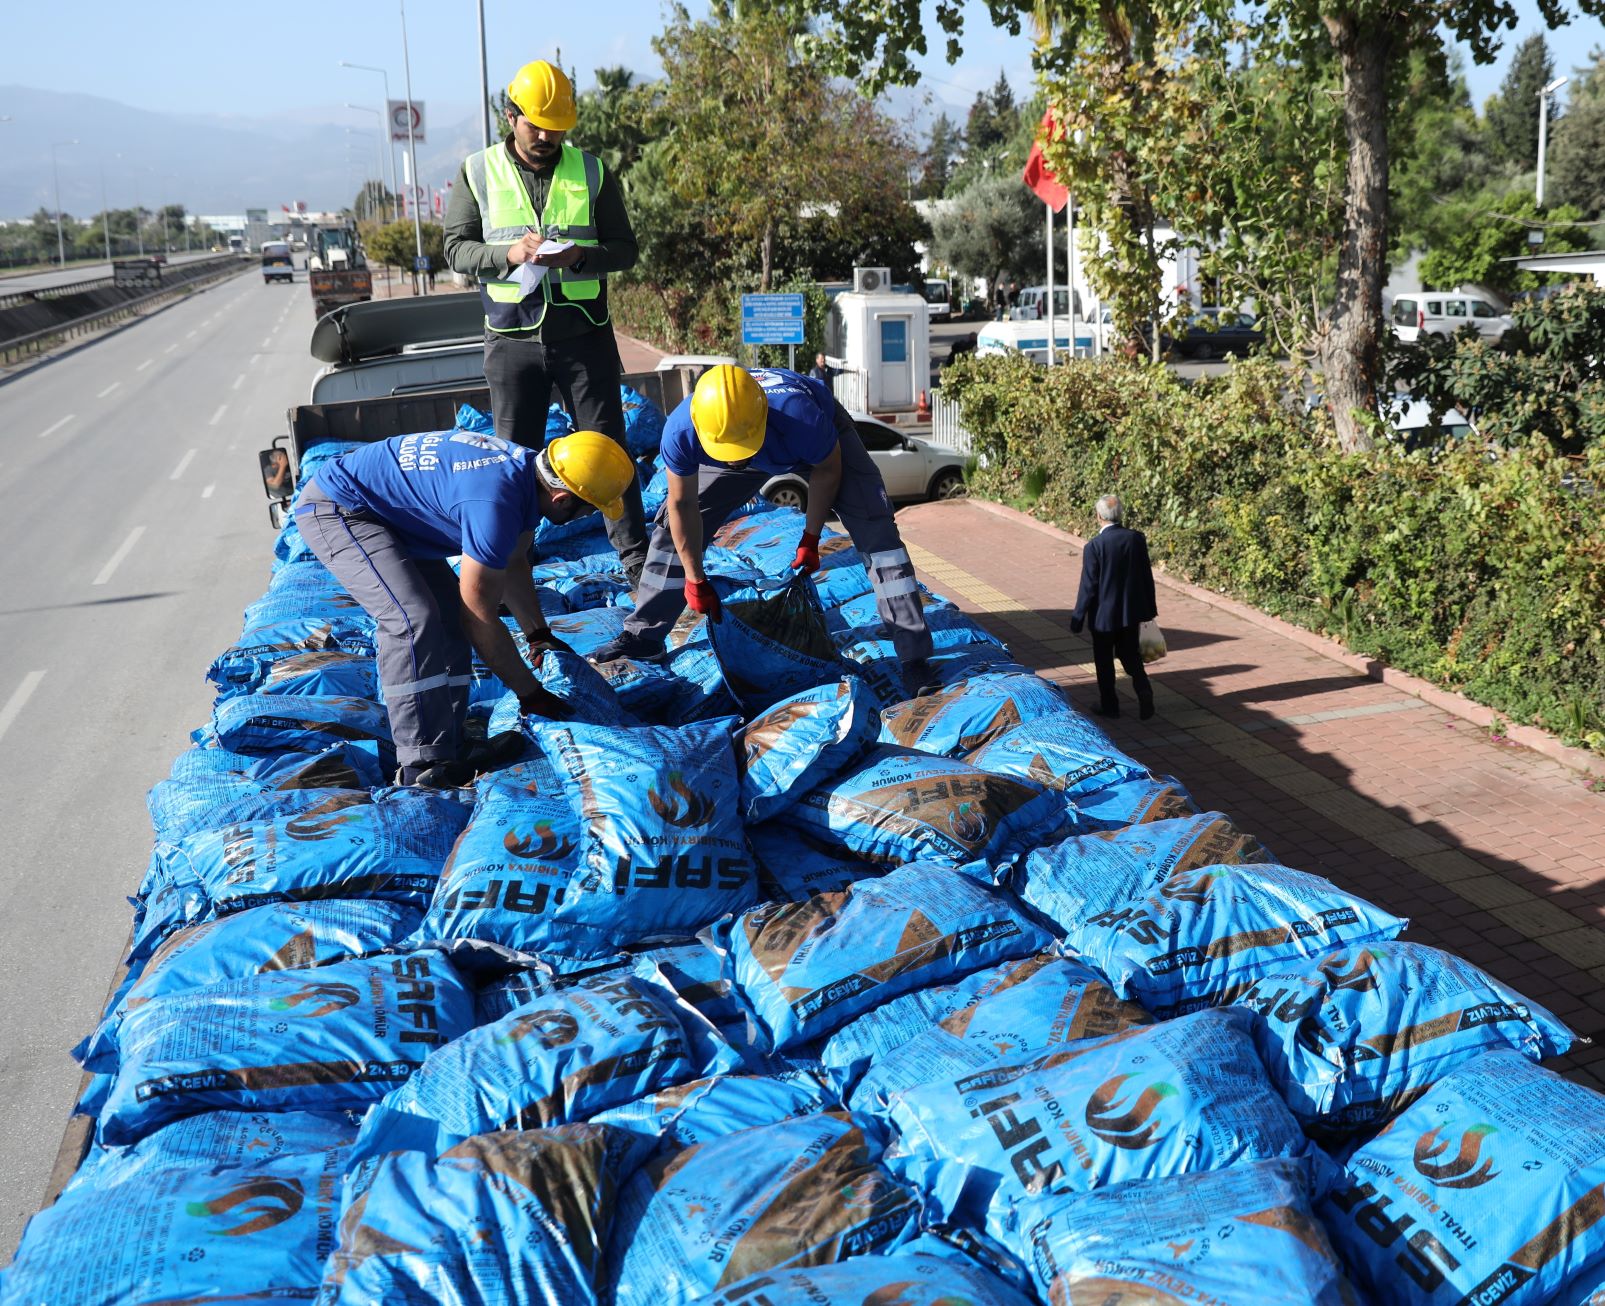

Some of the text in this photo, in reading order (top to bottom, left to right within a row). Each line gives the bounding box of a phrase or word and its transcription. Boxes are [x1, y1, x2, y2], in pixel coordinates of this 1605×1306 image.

[871, 773, 912, 788] KÖMÜR
[903, 779, 989, 813] AFİ
[508, 864, 559, 876] SİBİRYA
[614, 852, 751, 896] SAFİ
[392, 957, 449, 1044] SAFİ
[827, 977, 863, 1001] CEVİZ
[182, 1074, 227, 1090] CEVİZ
[369, 1064, 410, 1077] CEİZ
[969, 1091, 1076, 1196] AFİ
[1059, 1119, 1094, 1171] SİBİRYA
[1393, 1174, 1441, 1215] SİBİRYA
[315, 1214, 337, 1263] KÖMÜR
[707, 1216, 750, 1264] KÖMÜR
[848, 1222, 889, 1252] CEVİZ
[1329, 1175, 1462, 1294] SAF
[1439, 1210, 1478, 1252] İTHAL
[1479, 1271, 1518, 1306] CEVİZ
